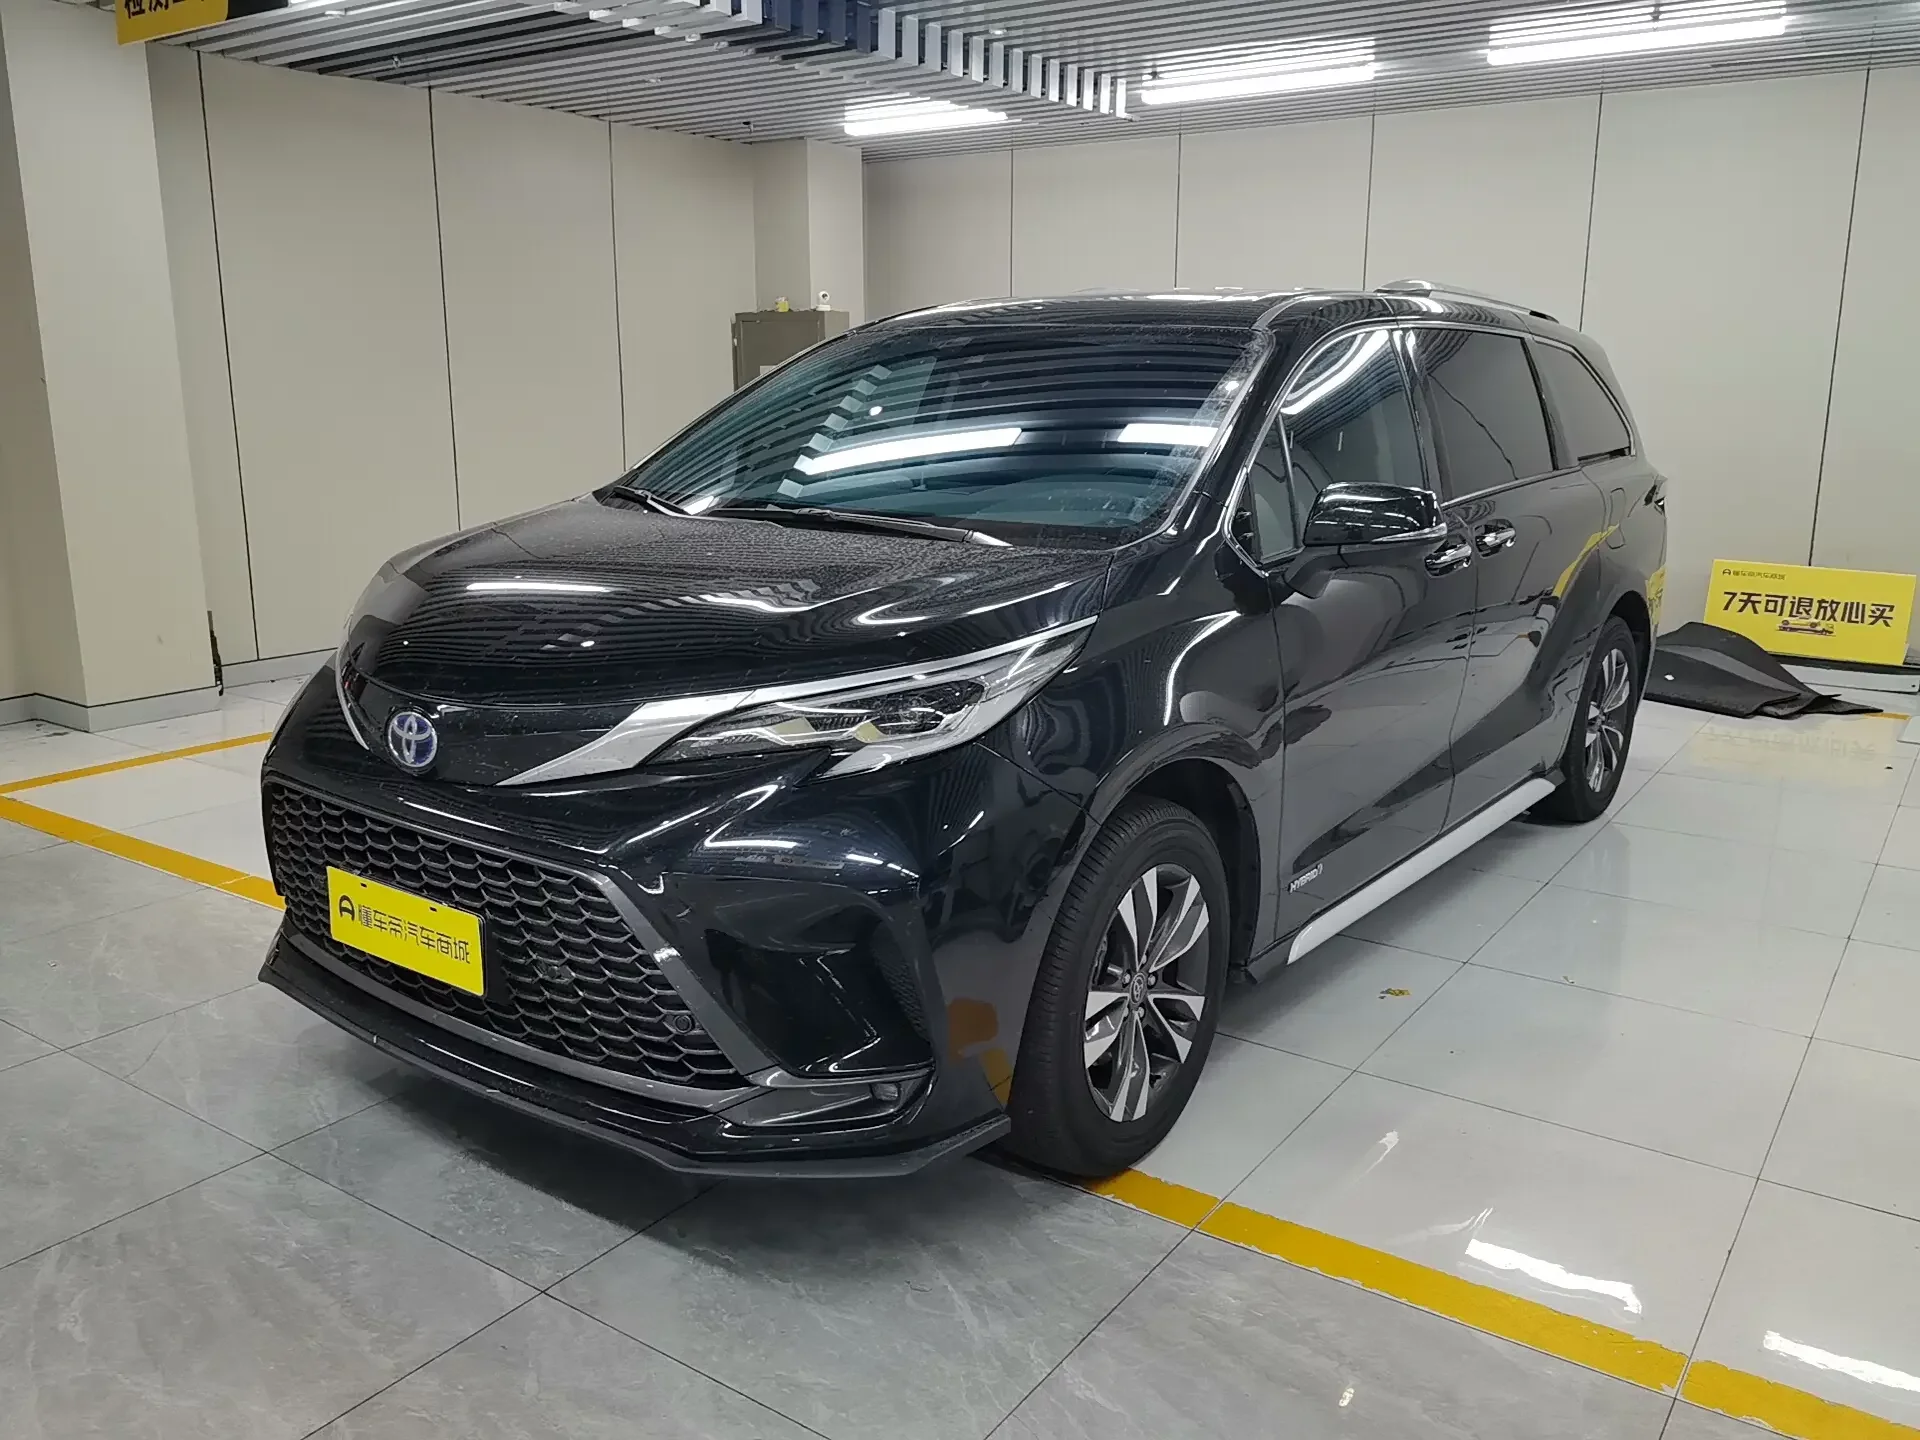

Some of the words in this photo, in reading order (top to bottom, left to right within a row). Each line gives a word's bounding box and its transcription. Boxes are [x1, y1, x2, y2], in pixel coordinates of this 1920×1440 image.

[1722, 591, 1895, 627] 7天可退放心买
